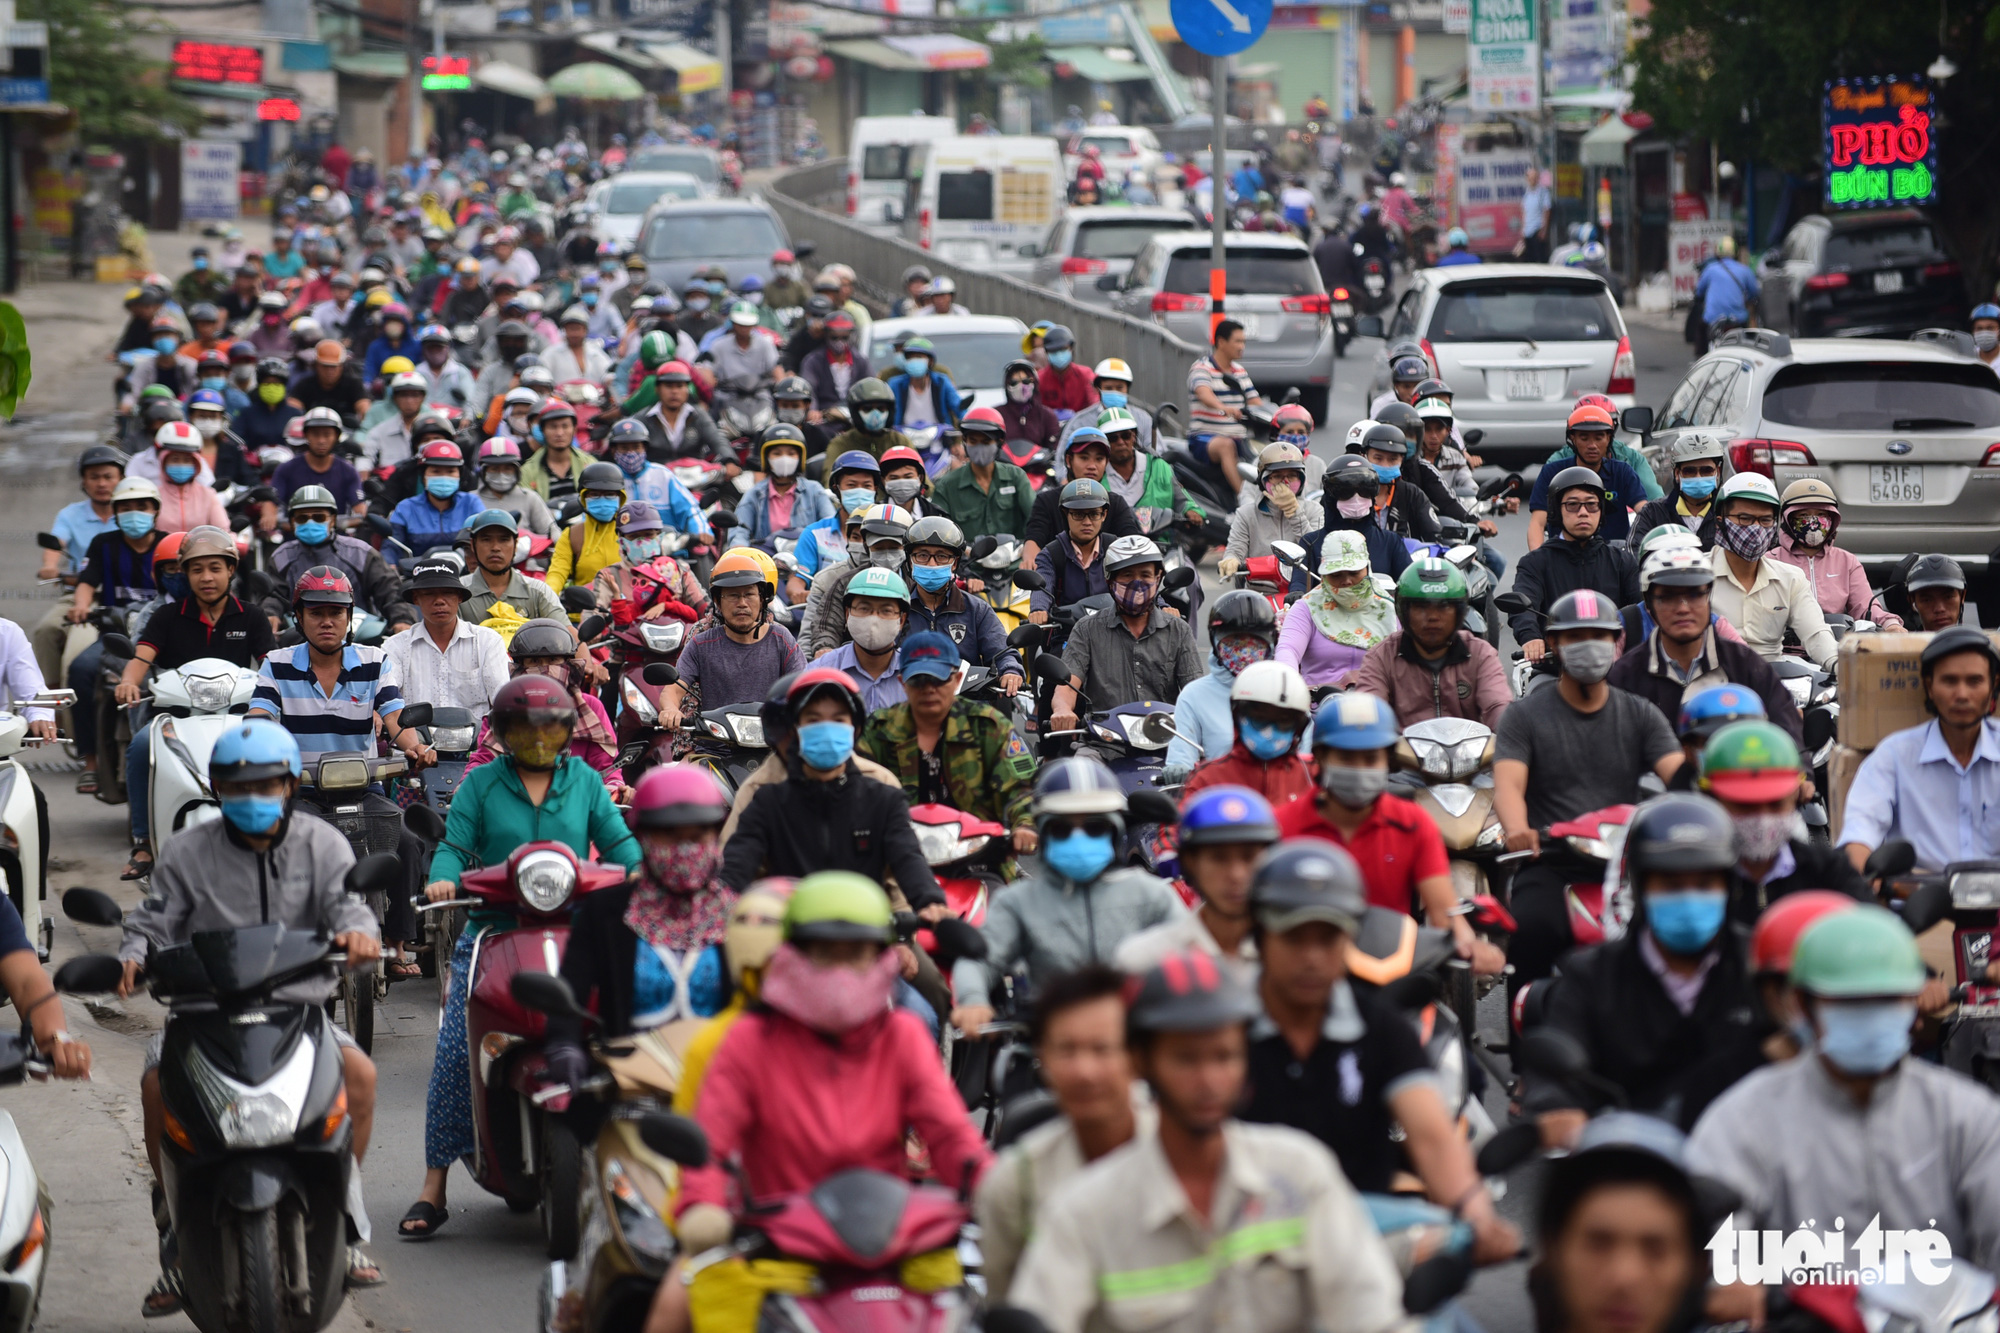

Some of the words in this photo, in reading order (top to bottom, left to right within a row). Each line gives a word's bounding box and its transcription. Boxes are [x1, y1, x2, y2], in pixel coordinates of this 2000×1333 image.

[1830, 104, 1929, 166] PHỞ
[1830, 164, 1889, 203] BÚN
[1892, 161, 1932, 199] BÒ
[1881, 466, 1911, 483] 51F
[1872, 483, 1922, 501] 549.69
[412, 564, 454, 577] Champion
[1421, 582, 1449, 594] Grab
